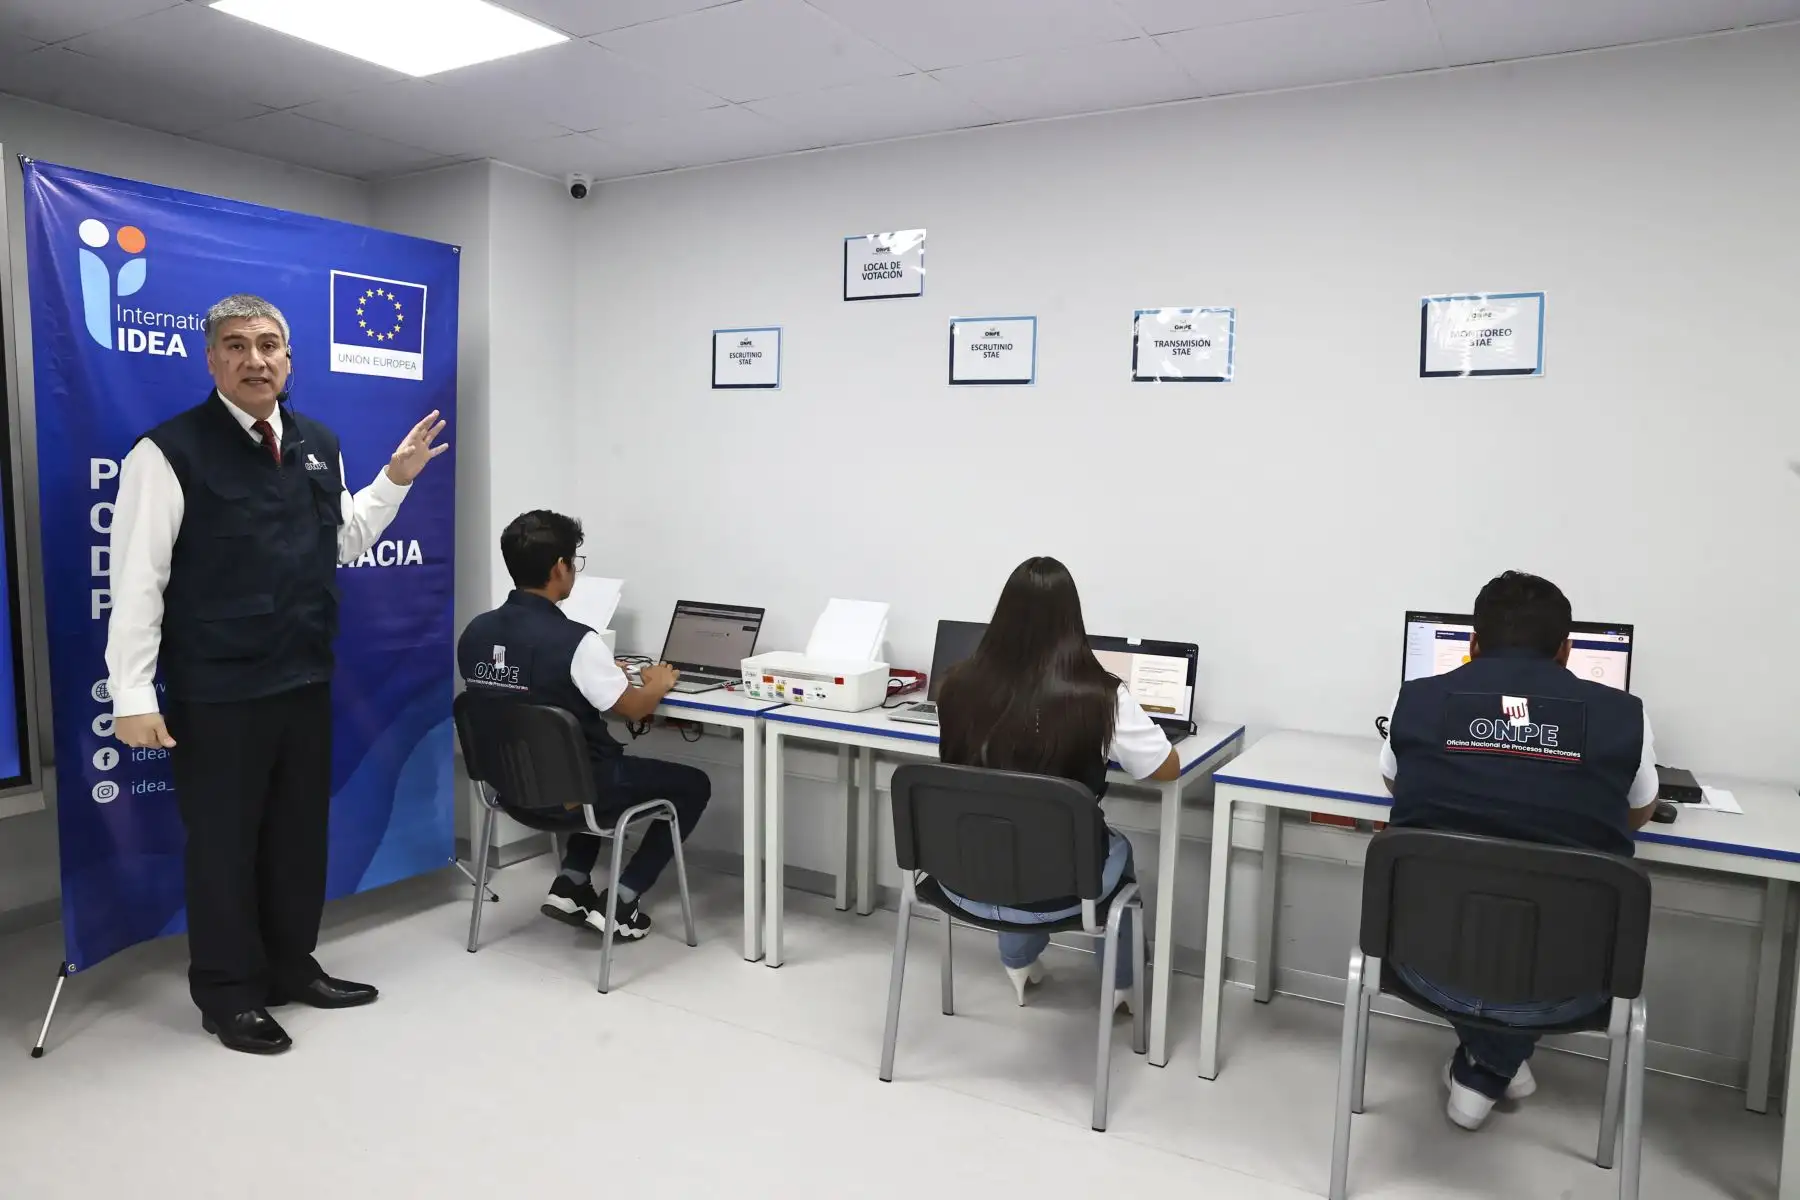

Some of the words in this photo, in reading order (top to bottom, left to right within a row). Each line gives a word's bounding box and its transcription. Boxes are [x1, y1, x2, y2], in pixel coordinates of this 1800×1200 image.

[863, 261, 889, 272] LOCAL
[890, 260, 901, 270] DE
[1450, 328, 1512, 338] MONITOREO
[117, 327, 188, 358] IDEA
[971, 343, 1014, 351] ESCRUTINIO
[1154, 337, 1211, 348] TRANSMISIÓN
[1469, 338, 1493, 347] STAE
[729, 351, 763, 359] ESCRUTINIO
[983, 351, 1000, 359] STAE
[1172, 348, 1192, 356] STAE
[373, 357, 417, 370] EUROPEA
[475, 662, 520, 684] ONPE
[1469, 718, 1559, 747] ONPE
[1446, 739, 1470, 747] Oficina
[1470, 740, 1501, 749] Nacional
[1501, 742, 1511, 750] de
[1511, 743, 1542, 754] Procesos
